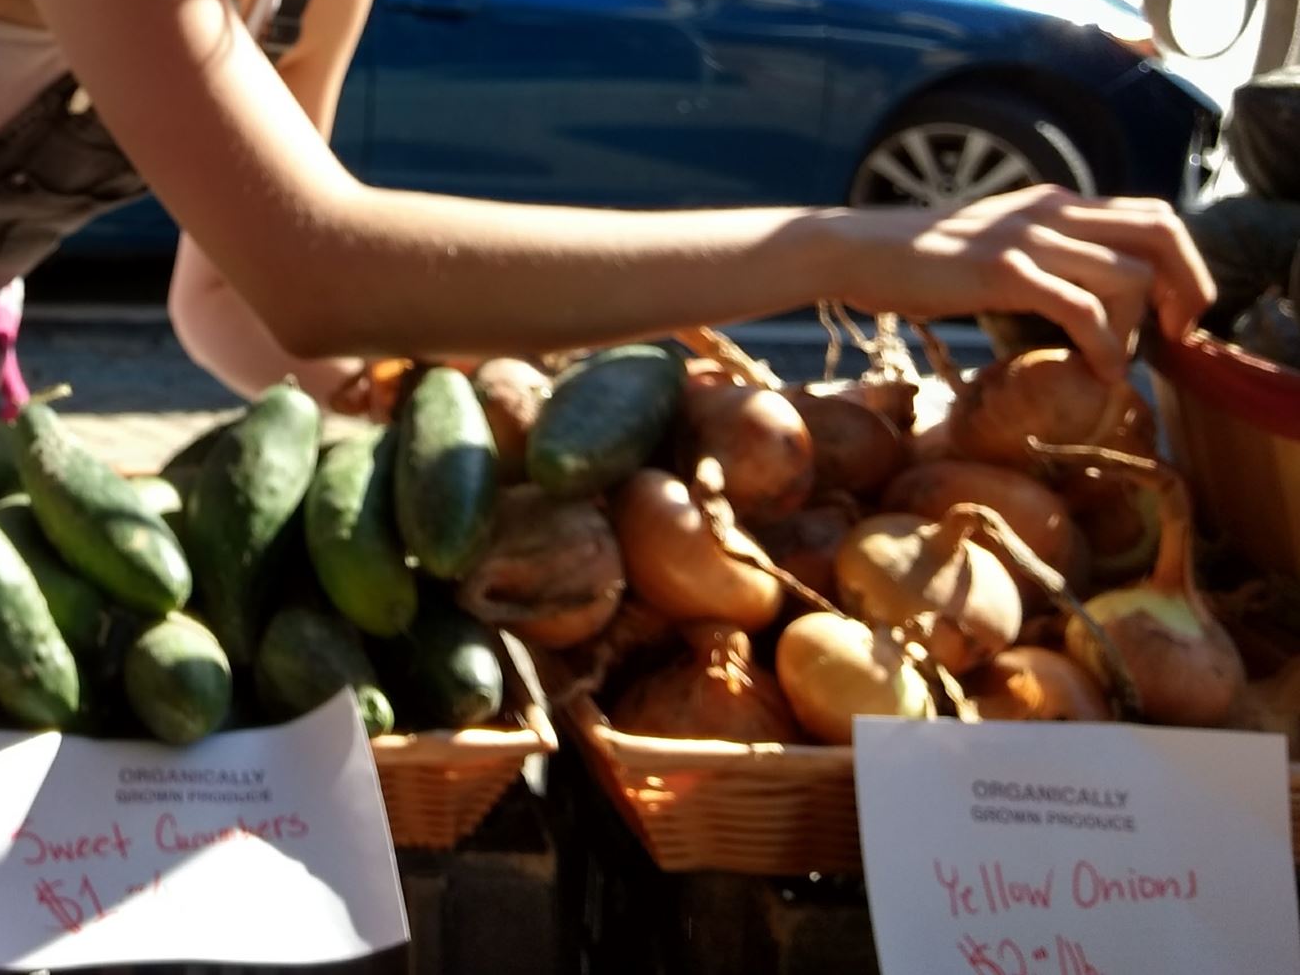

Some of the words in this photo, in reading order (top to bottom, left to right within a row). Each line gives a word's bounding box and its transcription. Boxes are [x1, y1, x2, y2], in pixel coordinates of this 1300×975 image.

[118, 766, 267, 786] ORGANICALLY
[971, 778, 1129, 809] ORGANICALLY
[970, 804, 1043, 827] GROWN
[1045, 809, 1137, 834] PRODUCE
[11, 819, 132, 867] Sweet
[933, 858, 1055, 917] Yellow
